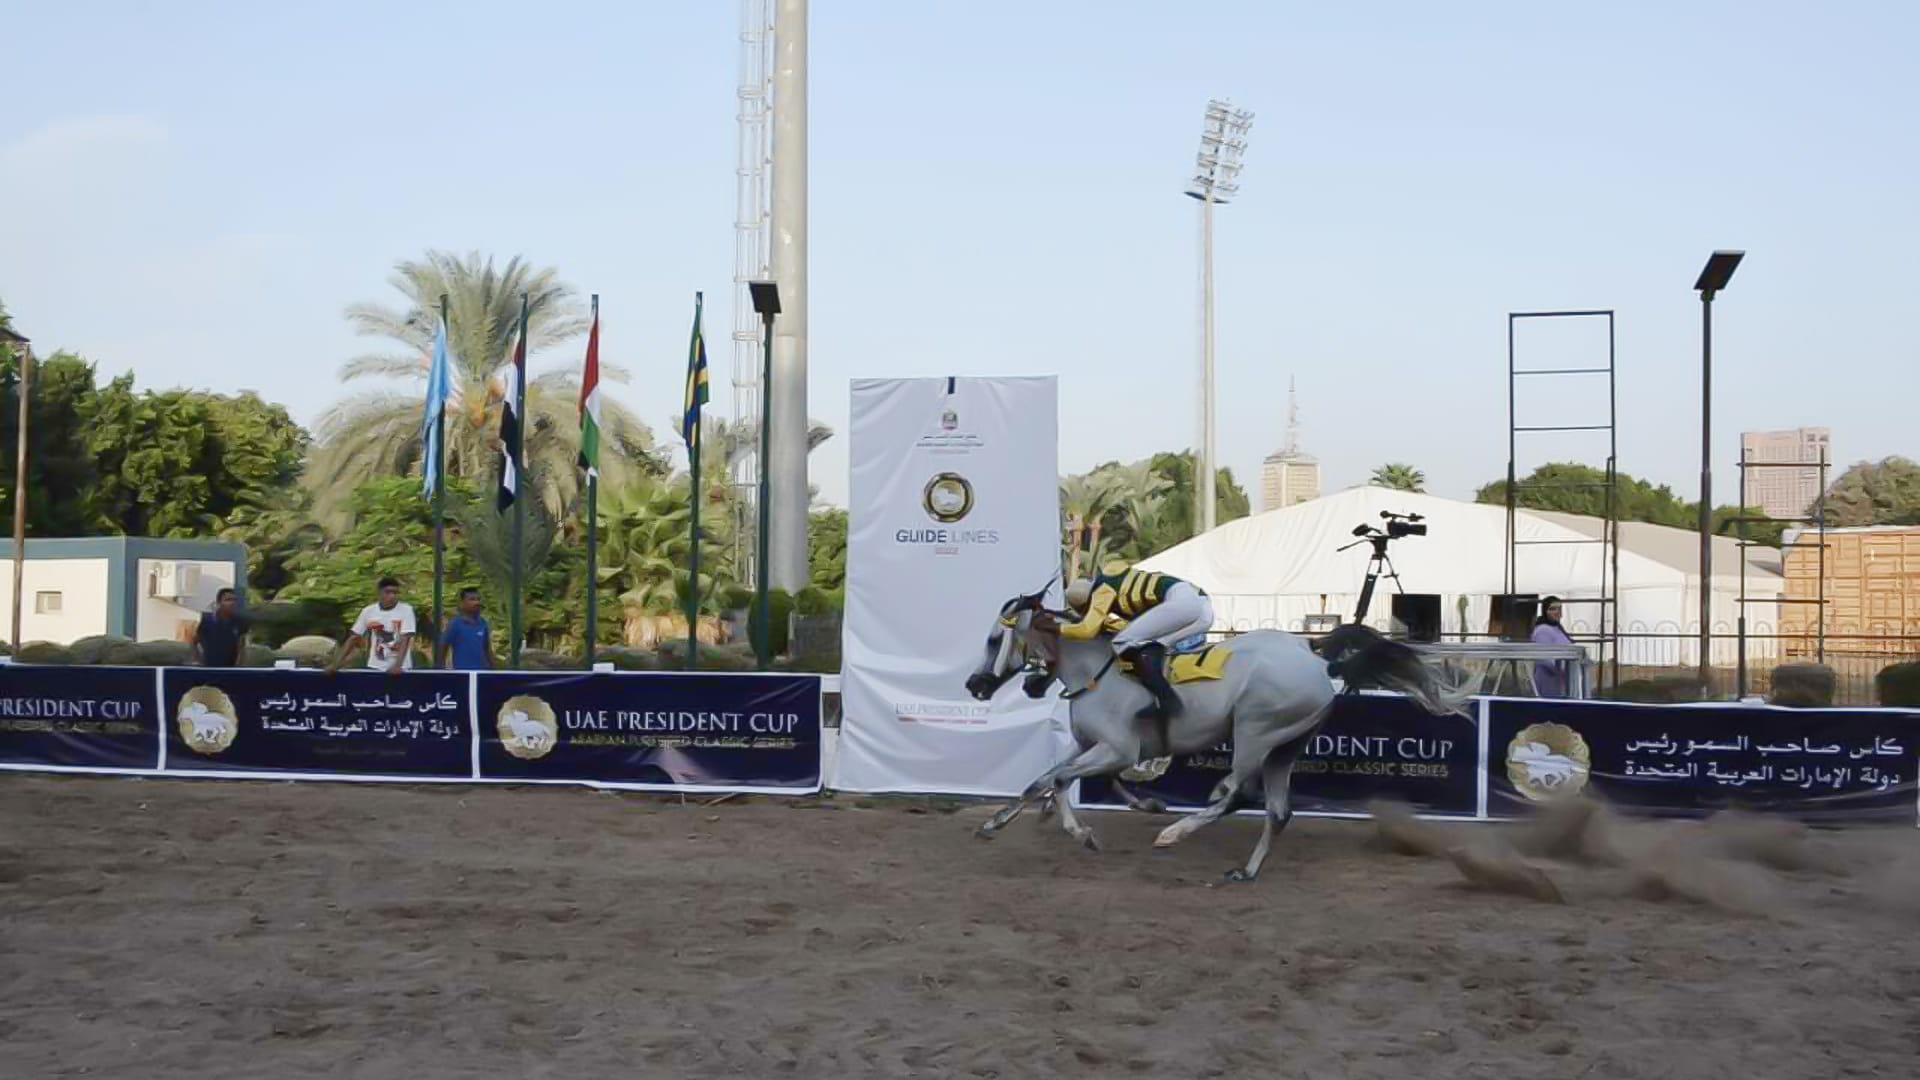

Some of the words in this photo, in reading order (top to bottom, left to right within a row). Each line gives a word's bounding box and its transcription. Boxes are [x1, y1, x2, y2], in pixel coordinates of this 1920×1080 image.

[896, 530, 947, 543] GUIDE
[952, 530, 999, 544] LINES
[0, 698, 96, 717] RESIDENT
[100, 700, 142, 719] CUP
[352, 694, 413, 712] صاحب
[566, 709, 608, 729] UAE
[615, 710, 744, 731] PRESIDENT
[749, 712, 799, 733] CUP
[1398, 737, 1453, 759] CUP
[1626, 733, 1677, 754] رئيس
[1682, 735, 1748, 755] السمو
[1756, 737, 1841, 756] صاحب
[1849, 736, 1904, 759] كأس
[1333, 762, 1395, 775] CLASSIC
[1400, 763, 1449, 777] SERIES
[1624, 760, 1698, 777] المتحدة
[1706, 761, 1773, 785] العربية
[1860, 766, 1900, 790] دولة
